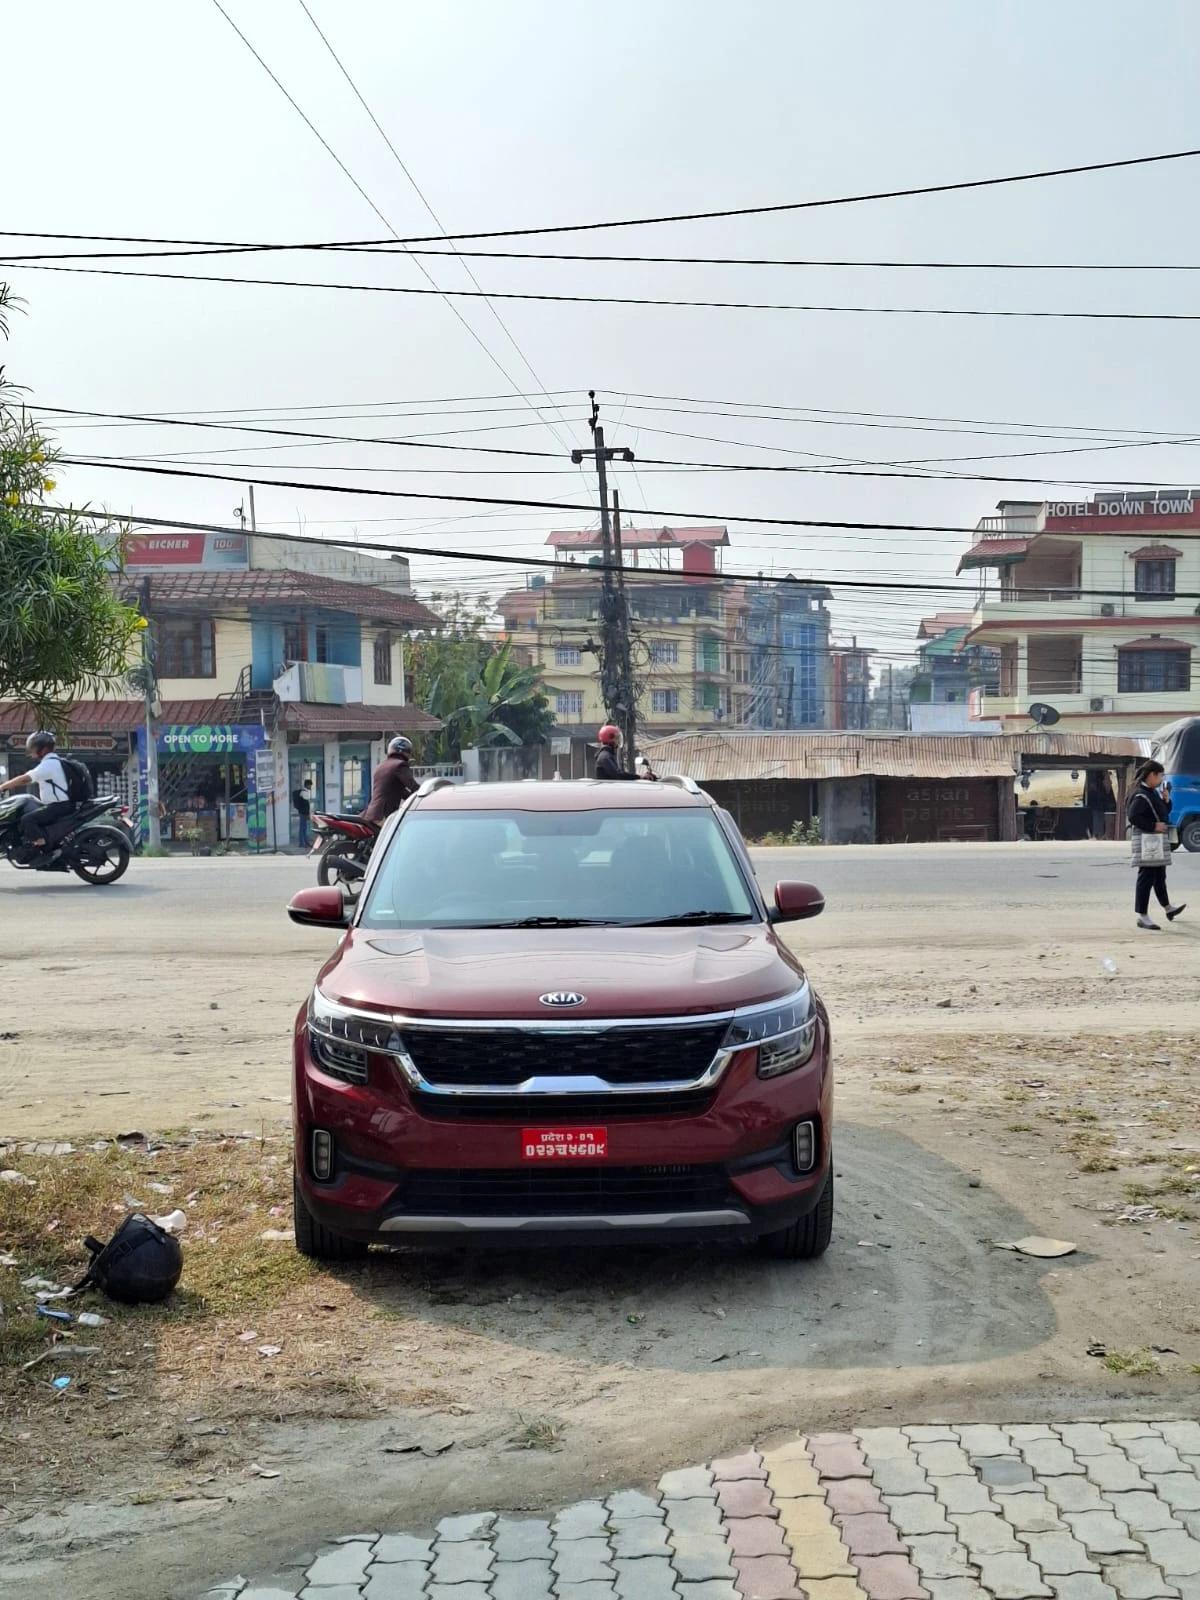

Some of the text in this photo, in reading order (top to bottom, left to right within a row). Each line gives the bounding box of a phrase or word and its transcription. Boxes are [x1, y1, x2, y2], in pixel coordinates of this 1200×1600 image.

[1045, 499, 1194, 517] HOTEL DOWN TOWN
[149, 539, 189, 549] EICHER
[163, 734, 239, 743] OPEN TO MORE
[547, 992, 578, 1003] KIA
